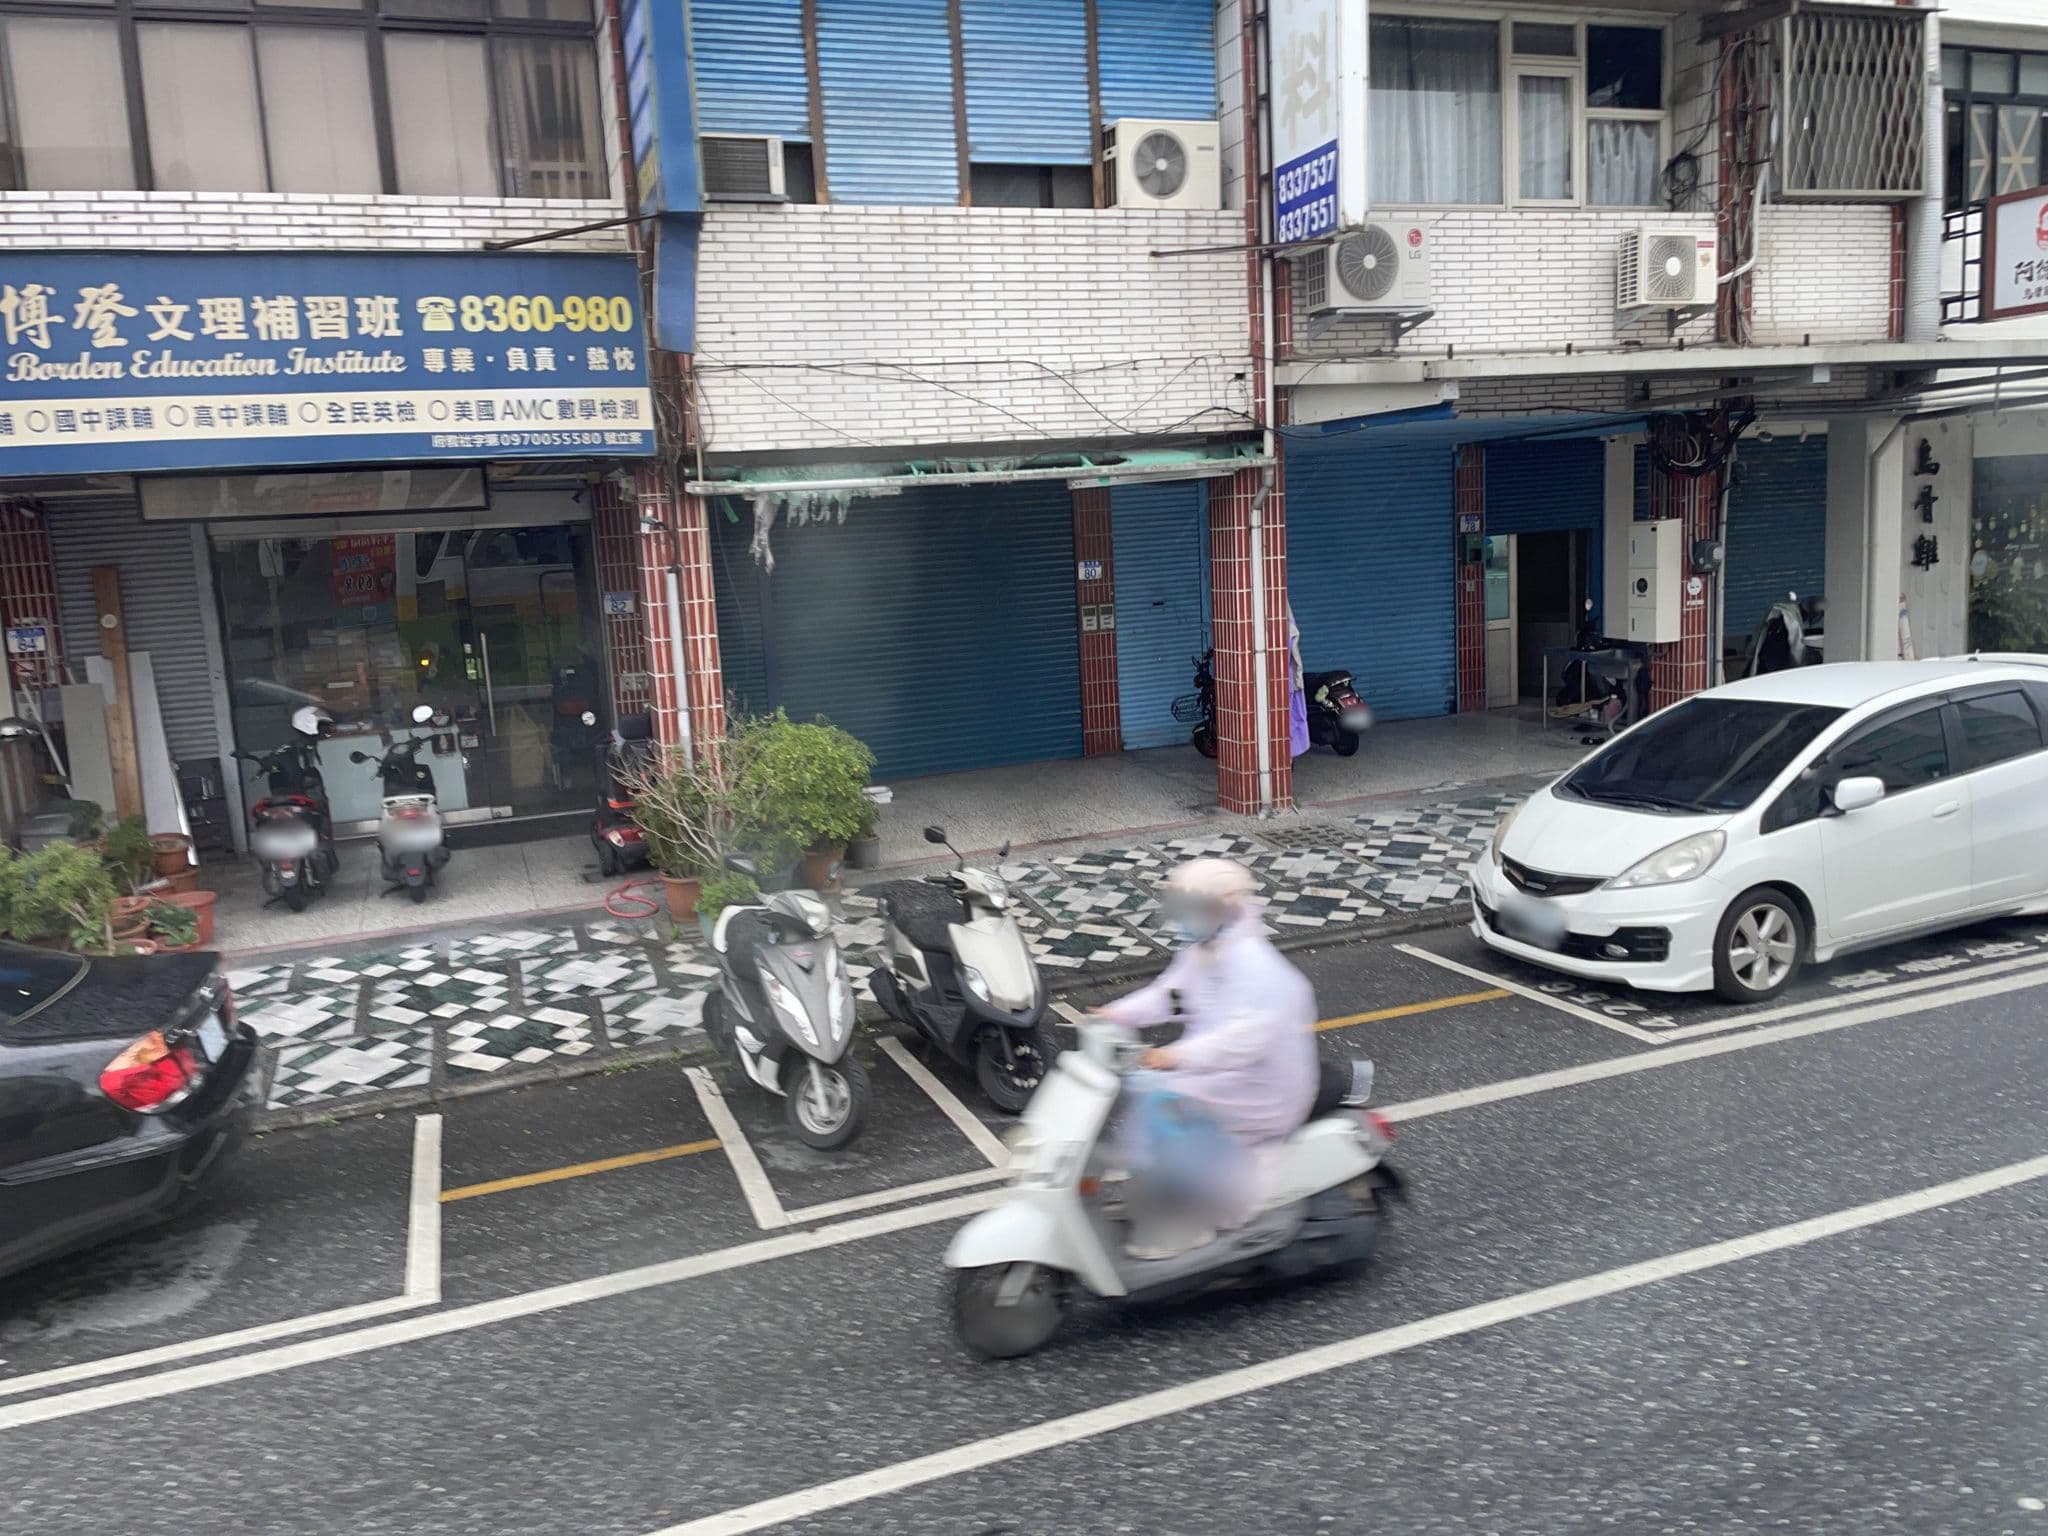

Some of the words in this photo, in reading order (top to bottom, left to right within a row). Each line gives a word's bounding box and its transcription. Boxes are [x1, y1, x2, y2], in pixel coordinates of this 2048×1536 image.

[1279, 150, 1336, 204] 8337537
[1279, 194, 1336, 243] 8337551
[0, 283, 403, 349] 博登文理補習班
[460, 295, 633, 332] 8360-980
[6, 352, 126, 381] Borden
[130, 349, 280, 377] Education
[284, 347, 408, 375] Institute
[1085, 568, 1097, 579] 80
[611, 601, 627, 613] 82
